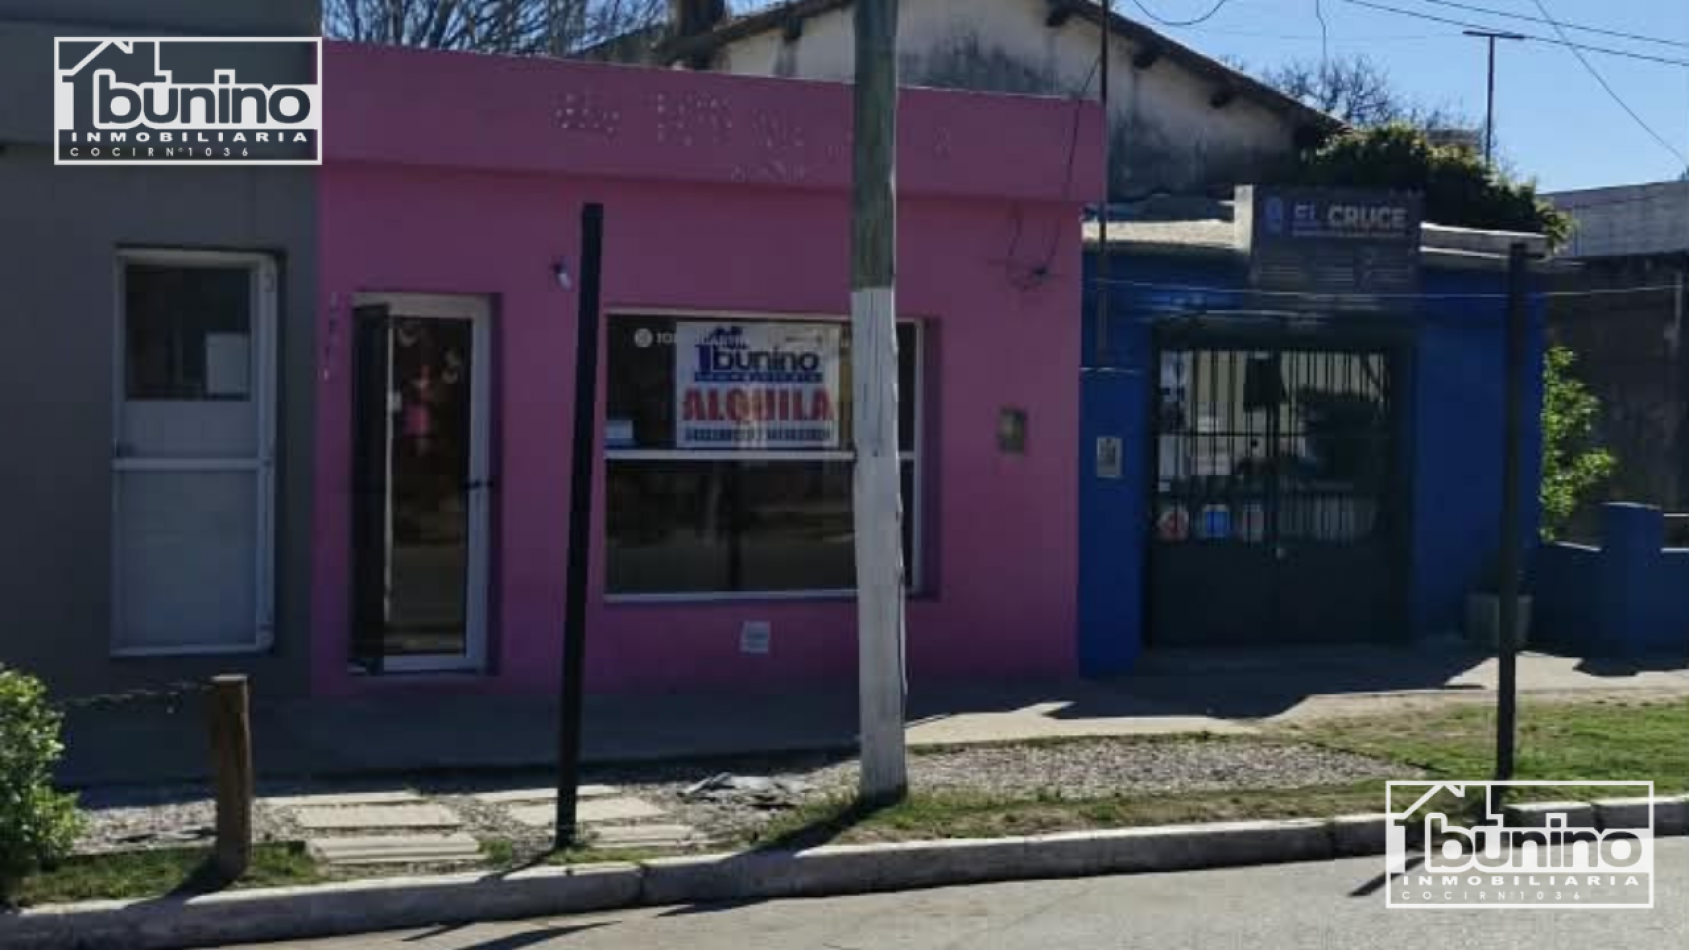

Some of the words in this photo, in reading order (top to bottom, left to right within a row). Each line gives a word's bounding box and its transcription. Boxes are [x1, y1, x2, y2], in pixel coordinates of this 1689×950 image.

[1294, 204, 1318, 227] EL
[1328, 204, 1408, 229] CRUCE
[712, 346, 820, 372] bunino
[682, 386, 834, 423] ALQUILA
